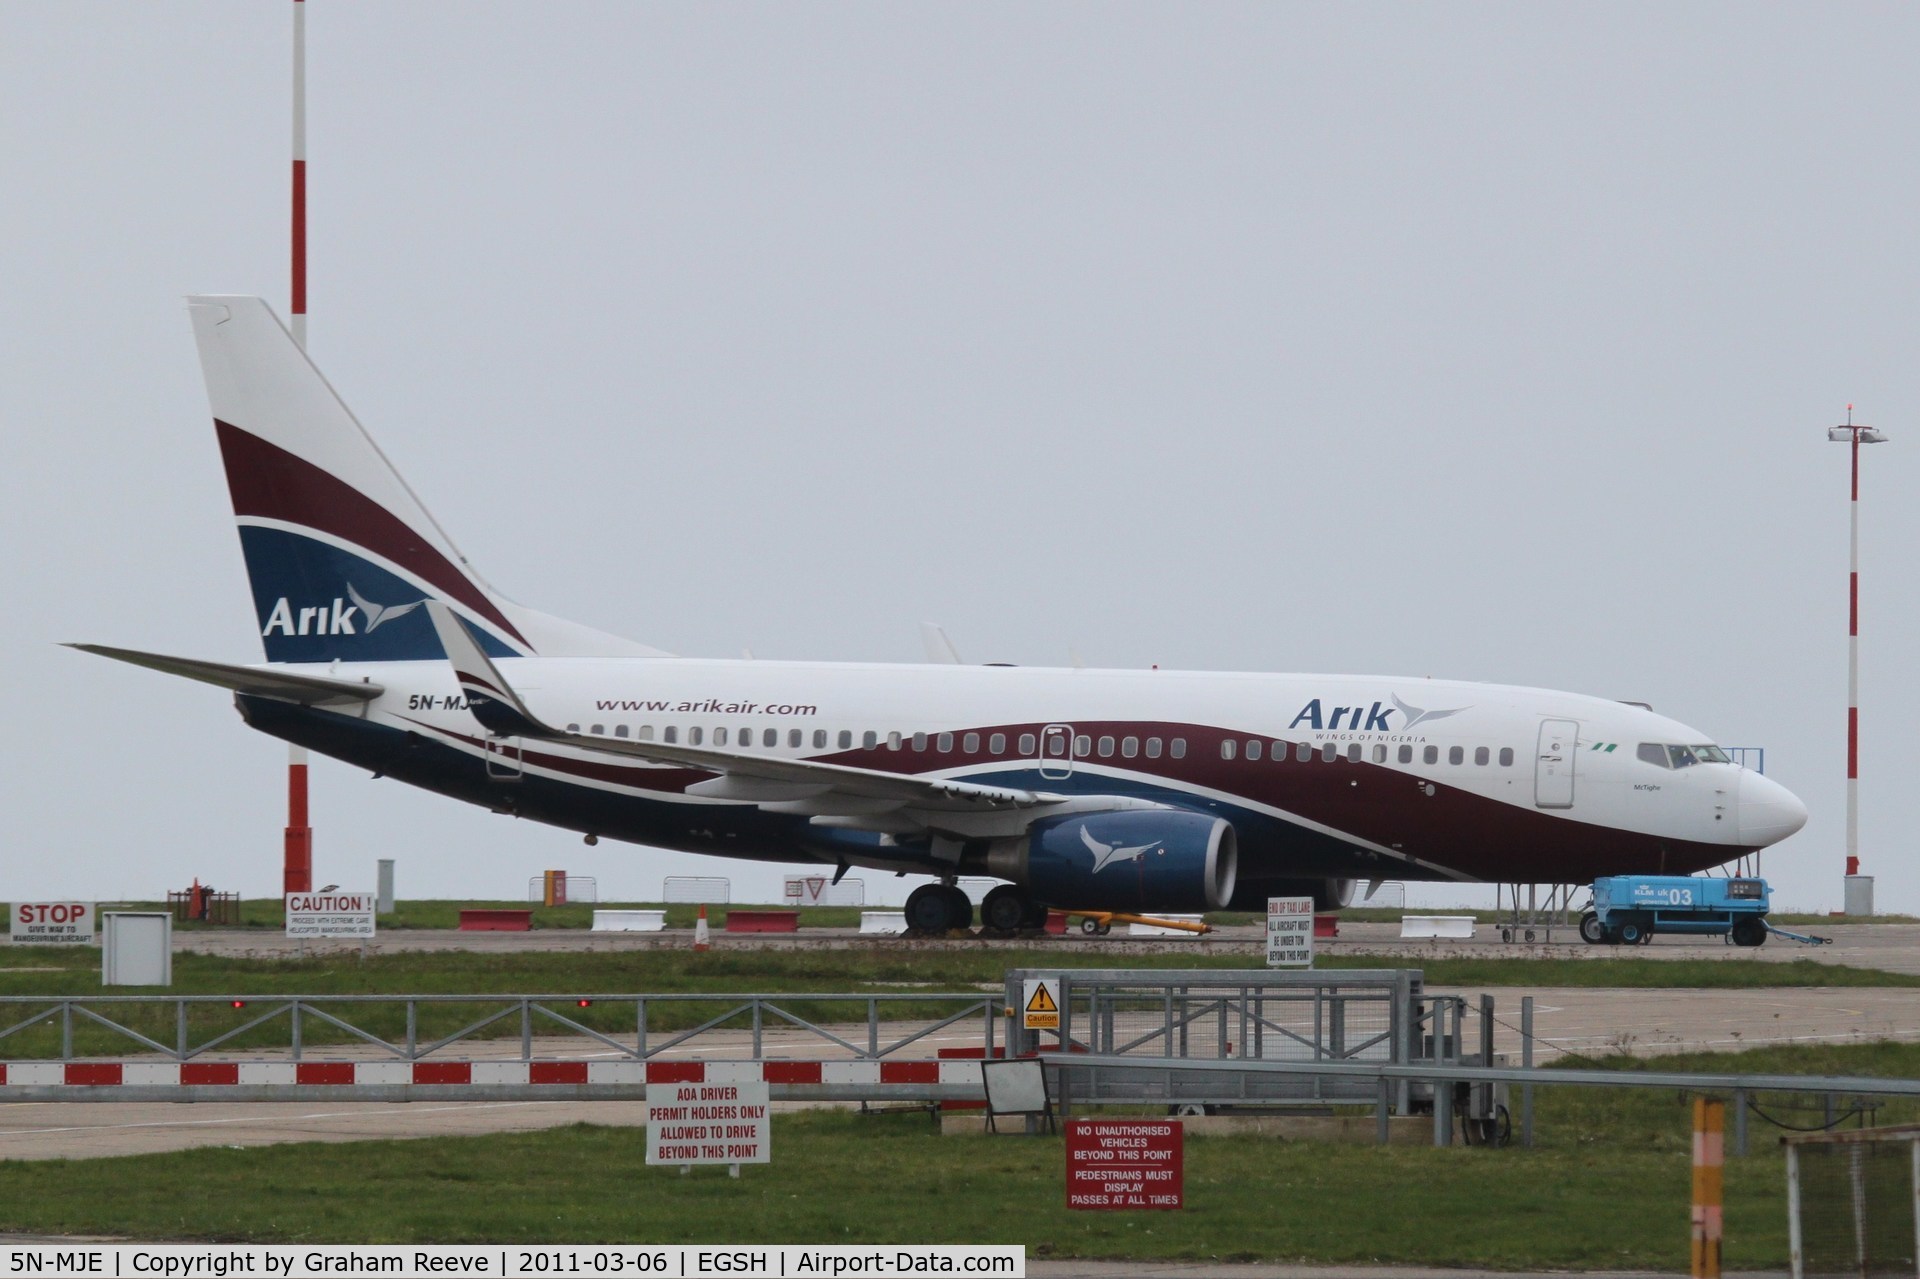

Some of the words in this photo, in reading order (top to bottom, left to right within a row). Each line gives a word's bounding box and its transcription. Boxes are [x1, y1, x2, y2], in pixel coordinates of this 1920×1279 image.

[596, 698, 818, 716] www.arikair.com
[1316, 733, 1354, 741] WINGS
[1377, 735, 1426, 743] NIGERIA
[290, 896, 362, 911] CAUTION
[1670, 889, 1692, 906] 03
[19, 904, 86, 924] STOP
[1269, 902, 1278, 914] END
[1279, 902, 1286, 914] OF
[1287, 902, 1297, 914] TAXI
[1298, 902, 1310, 914] LANE
[1278, 921, 1297, 932] AIRCRAFT
[1298, 920, 1310, 931] MUST
[1274, 936, 1280, 946] BE
[1280, 936, 1294, 946] UNDER
[1295, 936, 1304, 946] TOW
[1270, 951, 1286, 961] BEYOND
[1286, 950, 1296, 961] THIS
[1297, 950, 1310, 960] POINT
[677, 1088, 696, 1101] AOA
[701, 1087, 738, 1100] DRIVER
[650, 1108, 688, 1120] PERMIT
[692, 1106, 737, 1120] HOLDERS
[740, 1106, 765, 1118] ONLY
[660, 1126, 706, 1140] ALLOWED
[710, 1126, 723, 1138] TO
[726, 1125, 756, 1138] DRIVE
[1076, 1126, 1092, 1136] NO
[1095, 1126, 1171, 1136] UNAUTHORISED
[1100, 1138, 1148, 1148] VEHICLES
[659, 1146, 698, 1159] BEYOND
[702, 1145, 724, 1158] THIS
[728, 1144, 758, 1158] POINT
[1074, 1150, 1114, 1160] BEYOND
[1118, 1150, 1140, 1160] THIS
[1144, 1150, 1172, 1160] POINT
[1076, 1171, 1142, 1180] PEDESTRIANS
[1146, 1171, 1173, 1180] MUST
[1104, 1183, 1144, 1192] DISPLAY
[1072, 1195, 1108, 1204] PASSES
[1113, 1195, 1124, 1204] AT
[1128, 1195, 1146, 1204] ALL
[1149, 1195, 1178, 1204] TIMES
